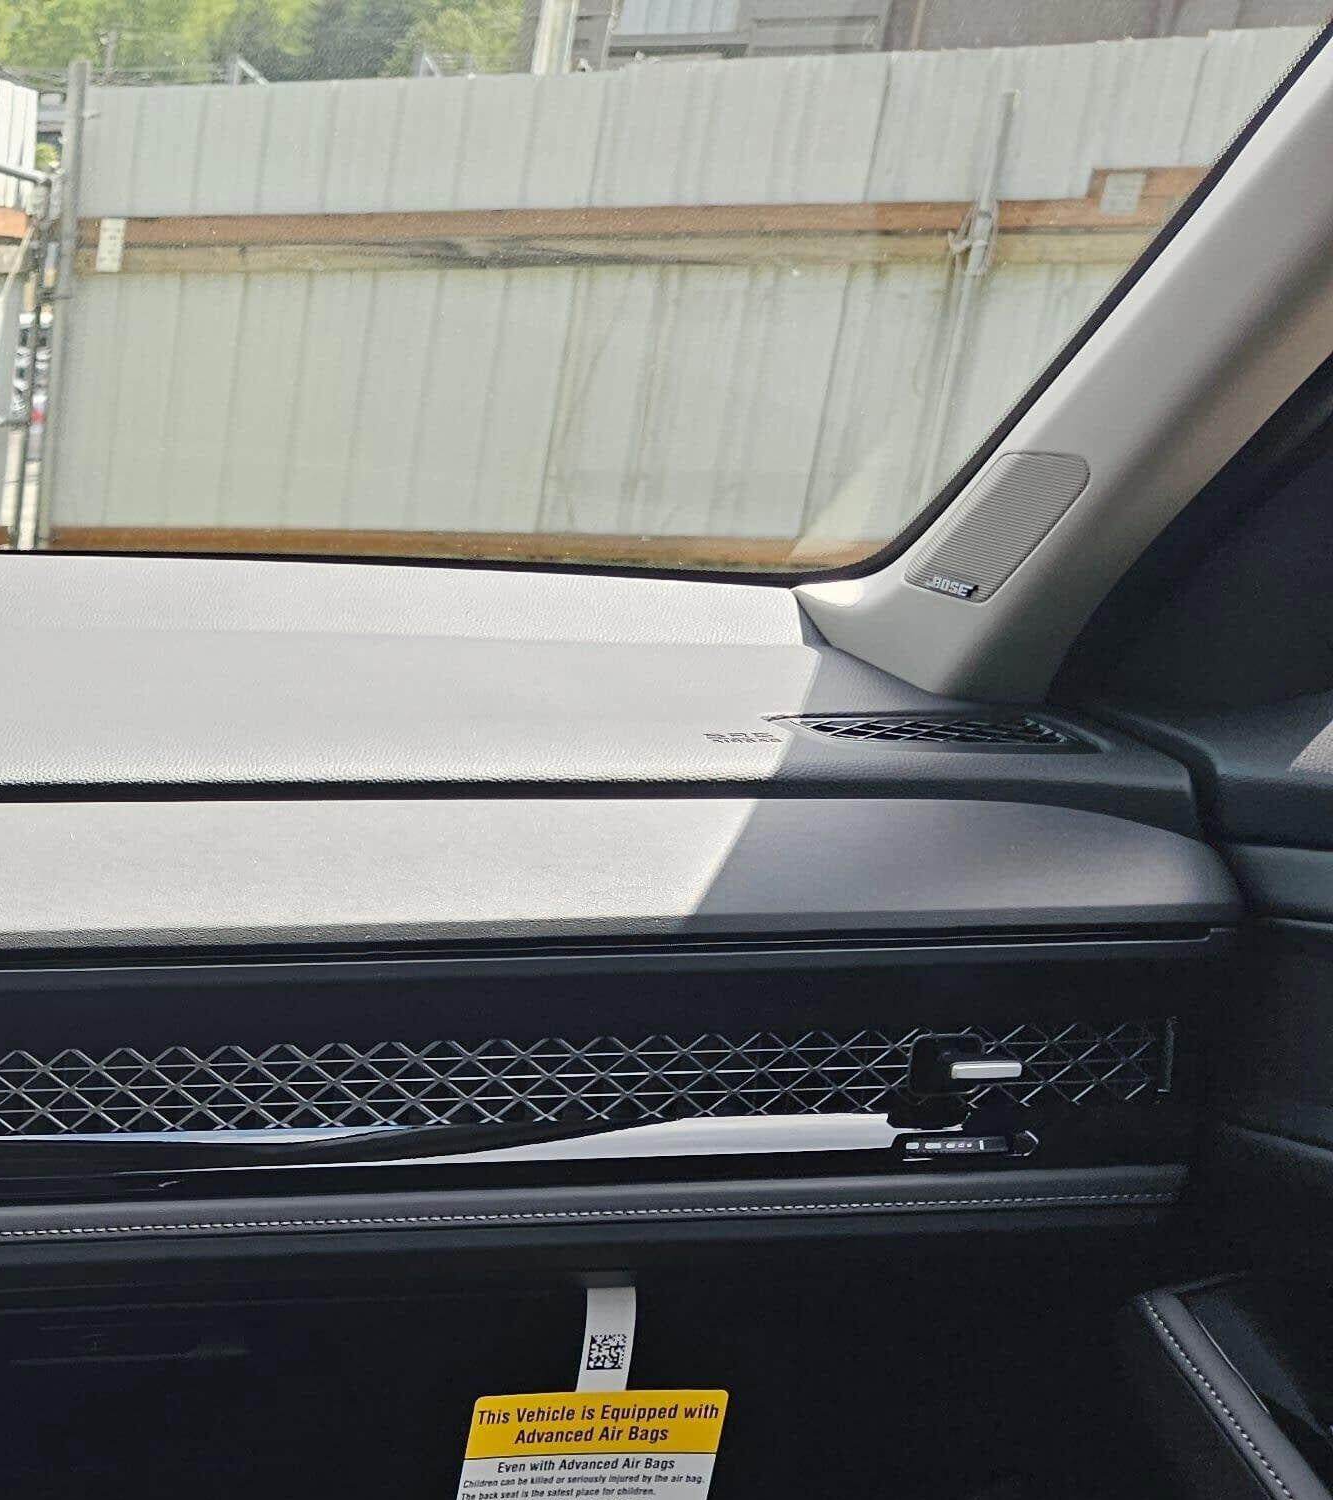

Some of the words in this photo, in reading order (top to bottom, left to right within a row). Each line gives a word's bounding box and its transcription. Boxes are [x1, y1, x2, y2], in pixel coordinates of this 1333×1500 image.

[933, 576, 973, 596] BOSE
[478, 1409, 511, 1425] This
[517, 1406, 575, 1422] Vehicle
[581, 1406, 595, 1420] is
[601, 1404, 679, 1422] Equipped
[684, 1404, 719, 1419] with
[515, 1427, 594, 1444] Advanced
[599, 1426, 623, 1441] Air
[628, 1426, 669, 1444] Bags
[497, 1462, 525, 1473] Even
[530, 1460, 555, 1471] with
[558, 1458, 618, 1470] Advanced
[622, 1458, 639, 1469] Air
[644, 1458, 675, 1471] Bags
[463, 1480, 498, 1488] Children
[531, 1476, 554, 1484] killed
[567, 1475, 606, 1484] seriously
[609, 1475, 639, 1484] injured
[642, 1474, 652, 1484] by
[654, 1474, 668, 1482] the
[671, 1474, 683, 1482] air
[685, 1474, 705, 1484] bag.
[479, 1491, 498, 1500] back
[501, 1491, 519, 1499] seat
[576, 1488, 599, 1497] place
[603, 1487, 615, 1495] for
